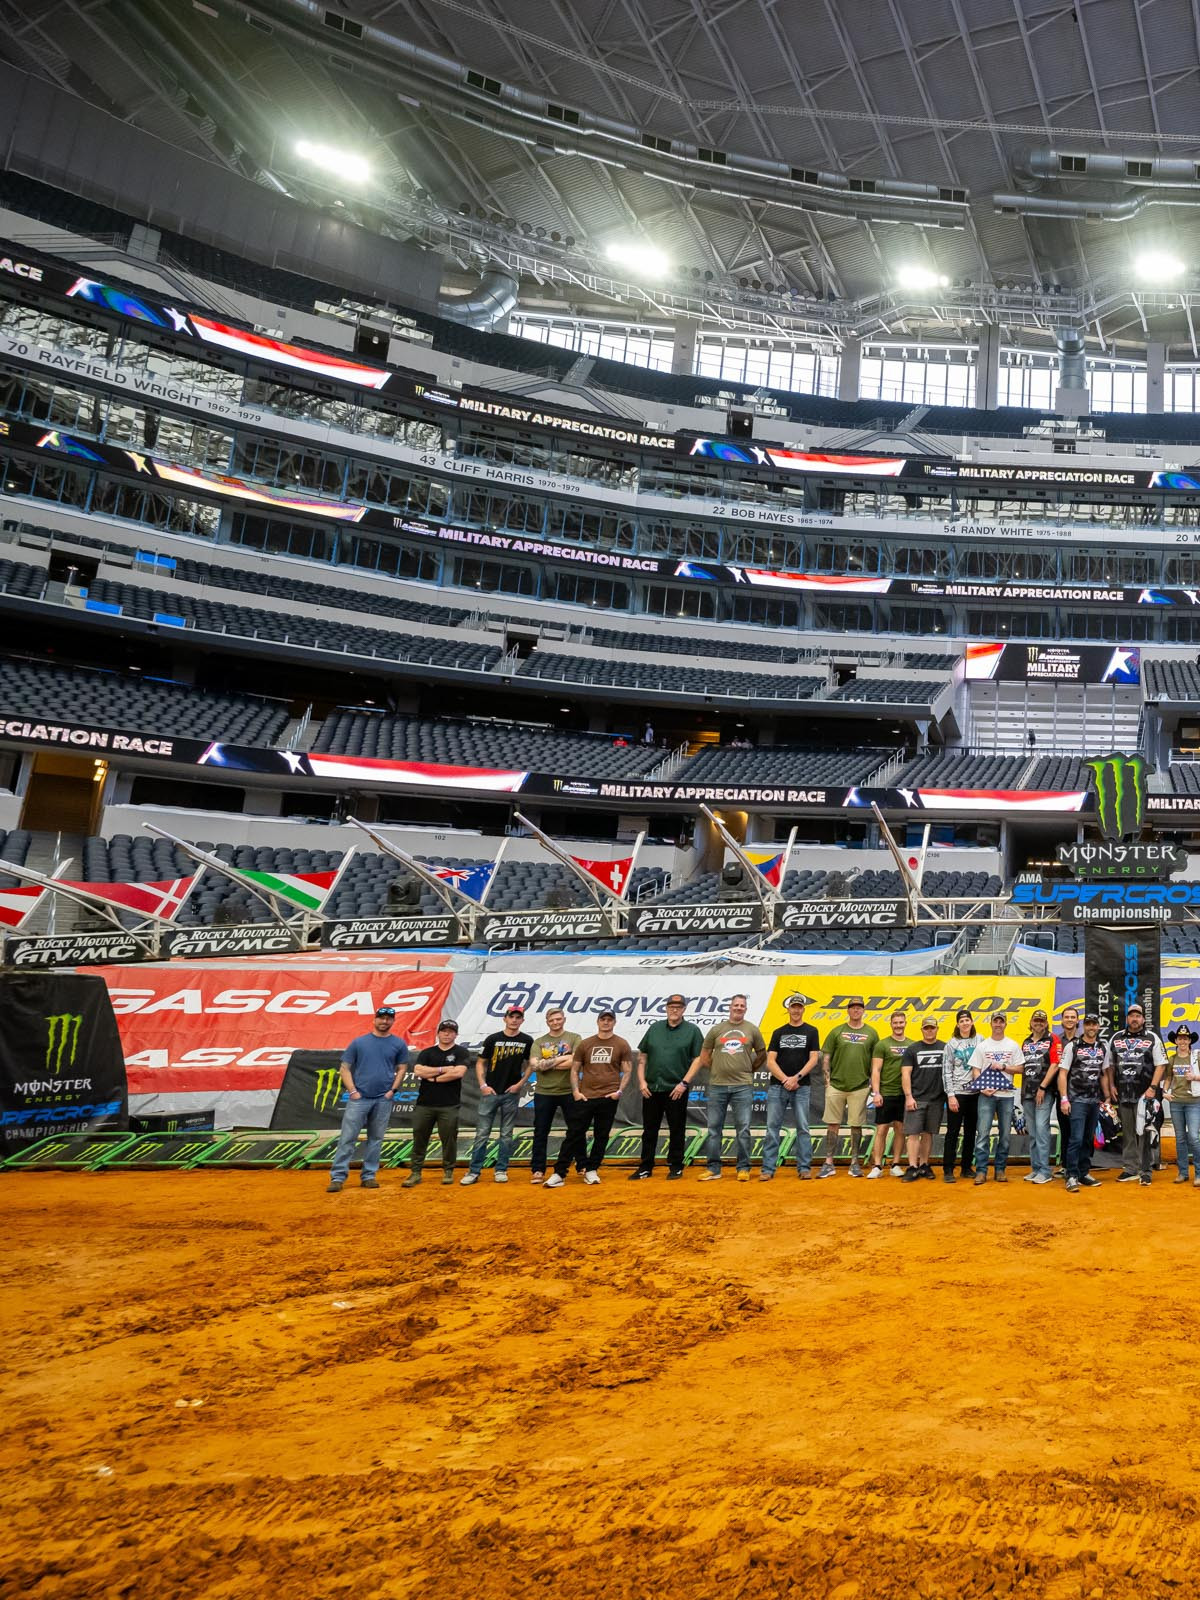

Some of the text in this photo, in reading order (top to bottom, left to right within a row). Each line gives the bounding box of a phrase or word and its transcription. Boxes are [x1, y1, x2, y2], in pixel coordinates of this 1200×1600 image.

[8, 340, 261, 422] 70 RAYFIELD WRIGHT 1967-1979
[460, 399, 532, 424] MILITARY
[531, 413, 638, 442] APPRECIATION
[639, 434, 675, 449] RACE
[419, 454, 580, 492] 43 CLIFF HARRIS 1970-1979
[959, 467, 1014, 480] MILITARY
[1015, 470, 1102, 484] APPRECIATION
[1104, 473, 1135, 484] RACE
[712, 506, 833, 525] 22 BOB HAYES 1965-1974
[944, 525, 956, 534] 54
[961, 525, 995, 536] RANDY
[1000, 527, 1033, 537] WHITE
[439, 528, 512, 550] MILITARY
[512, 540, 620, 567] APPRECIATION
[622, 557, 658, 572] RACE
[946, 585, 1001, 597] MILITARY
[1003, 587, 1091, 600] APPRECIATION
[1094, 590, 1124, 600] RACE
[1027, 664, 1080, 672] MILITARY
[113, 733, 172, 755] RACE
[601, 784, 673, 799] MILITARY
[675, 786, 784, 802] APPRECIATION
[788, 791, 825, 802] RACE
[1060, 844, 1176, 862] MONSTER
[1078, 866, 1159, 874] ENERGY
[1018, 874, 1042, 884] AMA
[655, 907, 753, 917] ROCKY MOUNTAIN
[800, 902, 898, 912] ROCKY MOUNTAIN
[1074, 906, 1172, 920] Championship
[349, 920, 450, 931] ROCKY MOUNTAIN
[502, 914, 602, 925] ROCKY MOUNTAIN
[190, 928, 291, 940] ROCKY MOUNTAIN
[34, 937, 135, 948] ROCKY MOUNTAIN
[820, 995, 1041, 1012] DUNLOP
[14, 1078, 92, 1096] MONSTER
[25, 1094, 81, 1104] ENERGY
[5, 1122, 88, 1140] CHAMPIONSHIP
